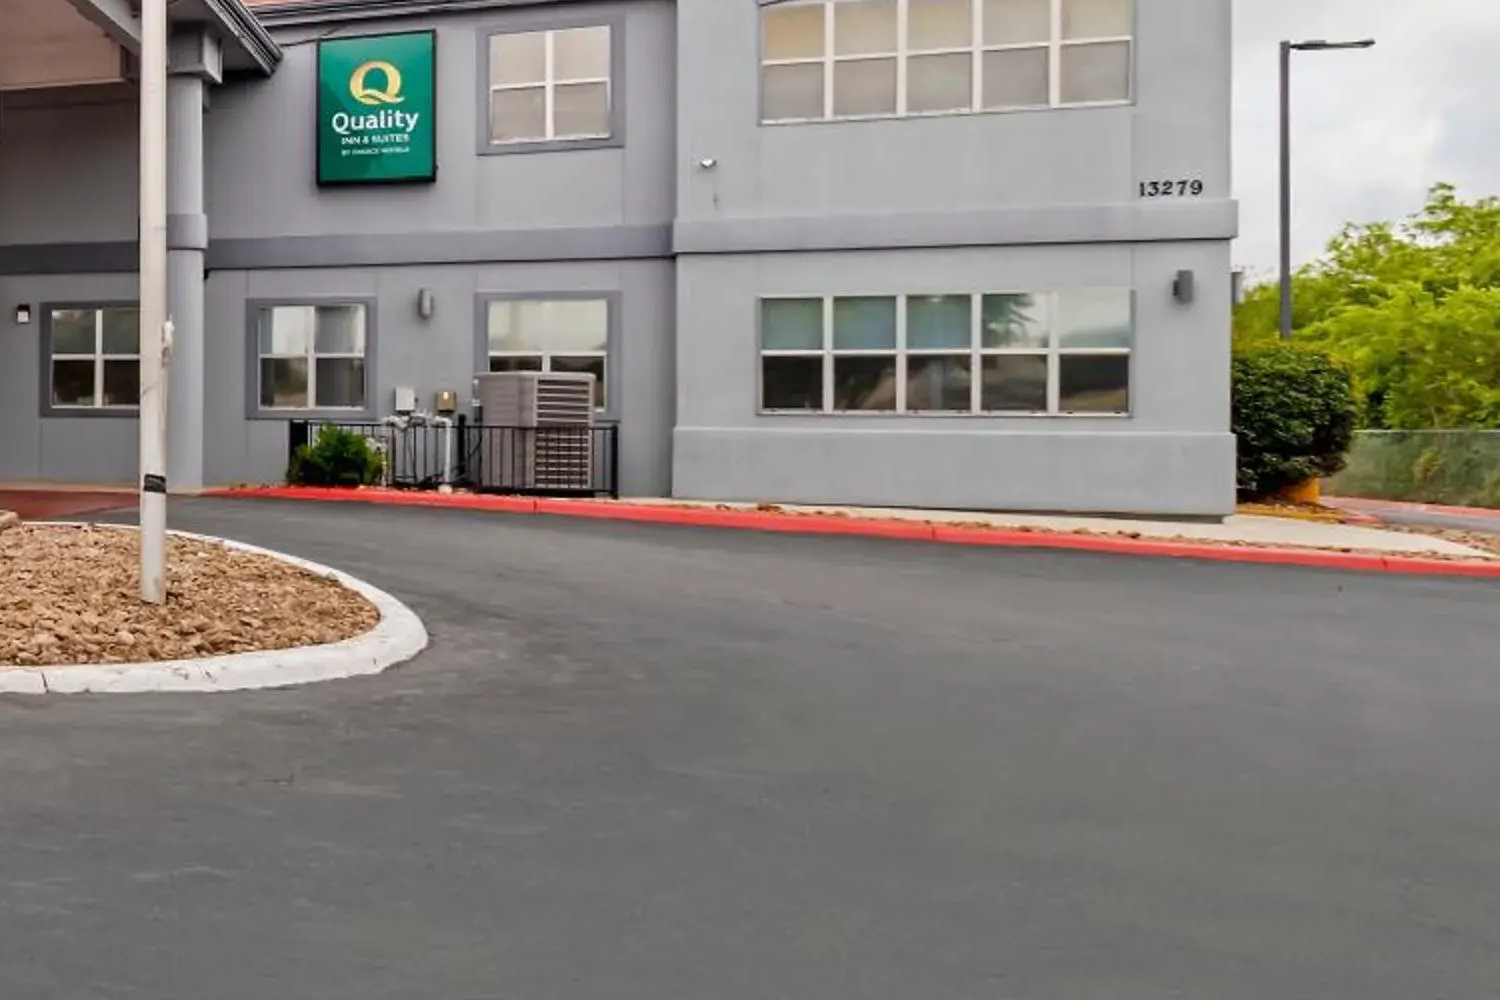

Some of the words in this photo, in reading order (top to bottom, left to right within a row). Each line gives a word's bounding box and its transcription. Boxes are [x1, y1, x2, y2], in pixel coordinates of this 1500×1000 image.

[350, 60, 405, 105] Q
[331, 110, 419, 134] Quality
[341, 136, 361, 145] INN
[371, 133, 410, 143] SUITES
[1140, 179, 1203, 196] 13279
